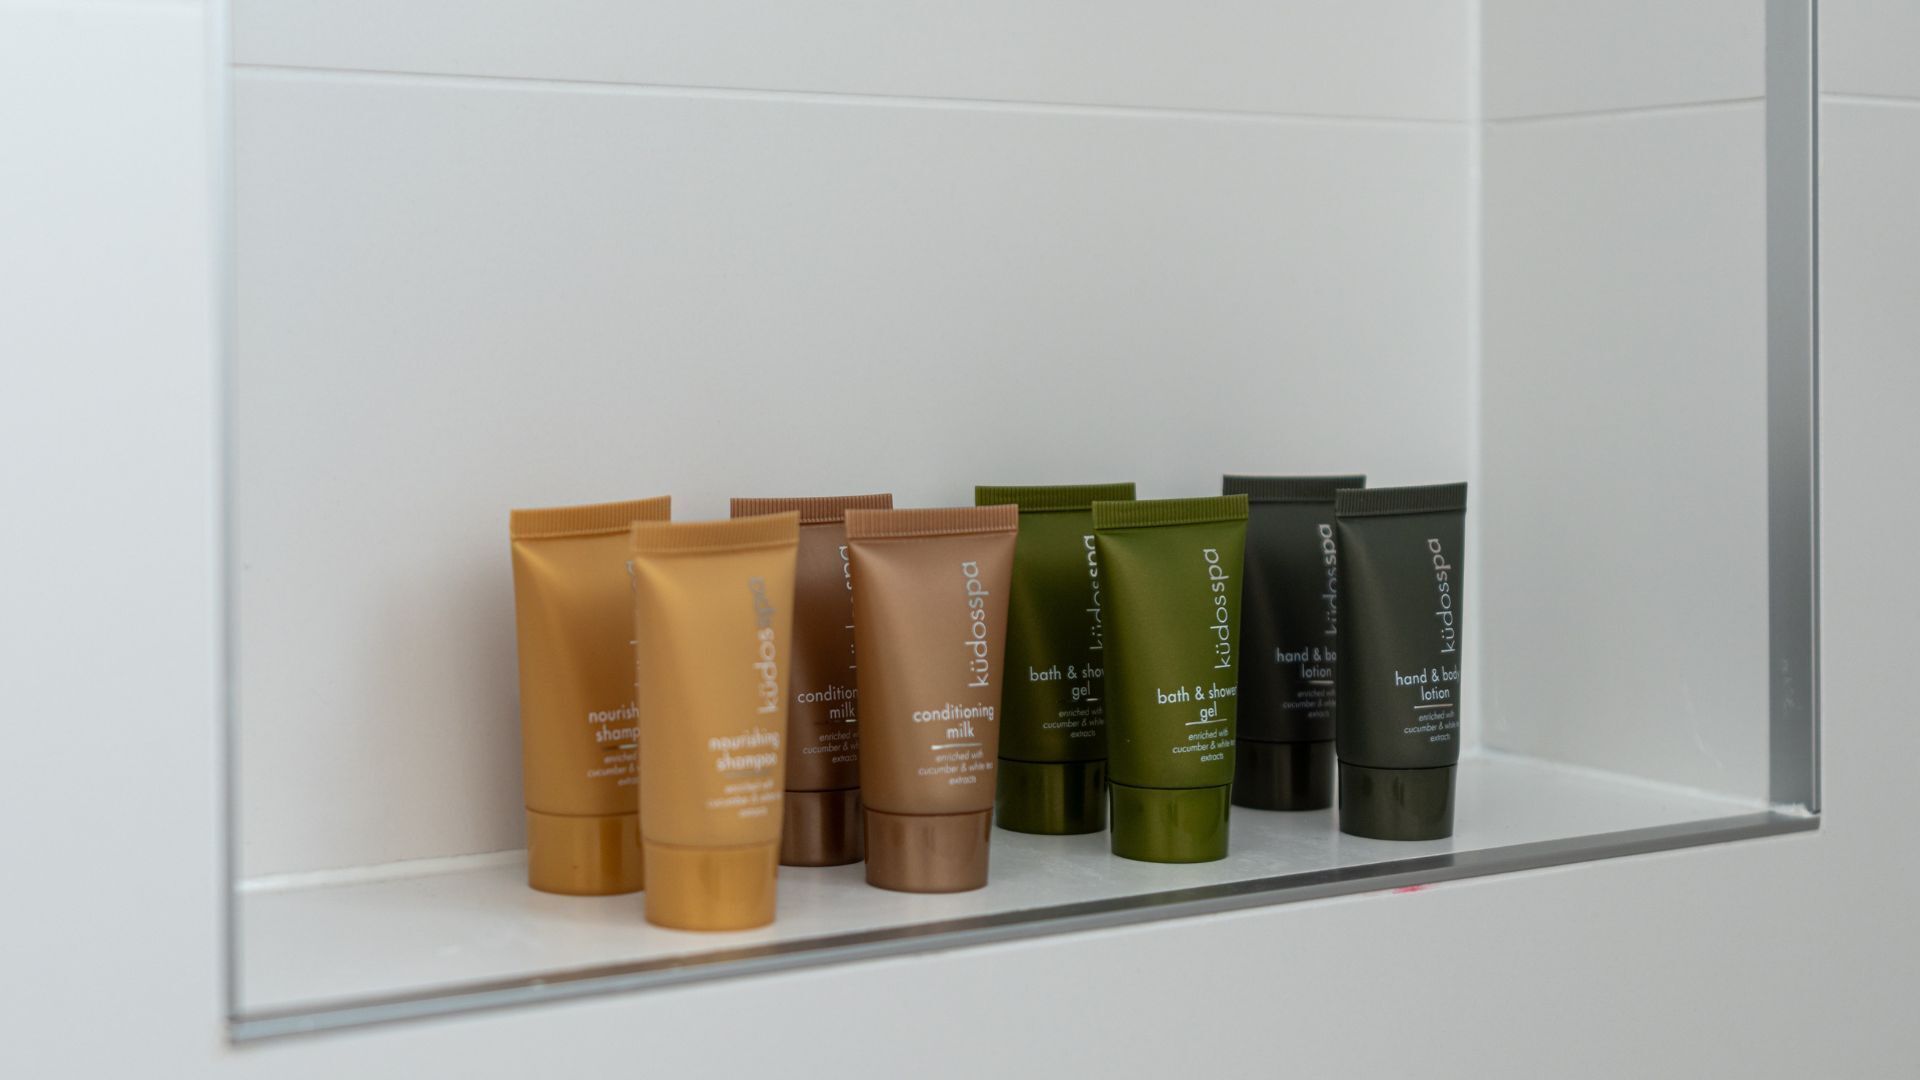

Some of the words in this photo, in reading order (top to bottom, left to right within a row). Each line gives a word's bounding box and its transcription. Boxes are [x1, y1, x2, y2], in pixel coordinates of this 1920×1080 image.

[1428, 538, 1455, 653] küdosspa
[1203, 548, 1231, 668] küdosspa
[962, 561, 989, 688] küdosspa
[1276, 646, 1309, 662] hand
[1313, 647, 1321, 661] &
[1325, 645, 1336, 661] bo
[1029, 665, 1061, 682] bath
[1067, 665, 1077, 679] &
[1082, 663, 1104, 678] sho
[1301, 664, 1332, 678] lotion
[1395, 668, 1427, 686] hand
[1431, 668, 1440, 682] &
[797, 684, 858, 703] condition
[1072, 680, 1090, 700] gel
[1157, 687, 1189, 704] bath
[1195, 686, 1205, 700] &
[1421, 686, 1450, 701] lotion
[588, 701, 639, 723] nourish
[829, 701, 855, 719] milk
[912, 702, 994, 722] conditioning
[1200, 701, 1217, 722] gel
[947, 721, 974, 739] milk
[1042, 718, 1079, 729] cucumber
[1403, 723, 1437, 734] cucumber
[595, 724, 640, 742] shamp
[708, 725, 780, 752] nourishing
[1188, 729, 1217, 740] enriched
[936, 750, 970, 762] enriched
[1172, 742, 1208, 753] cucumber
[918, 764, 958, 776] cucumber
